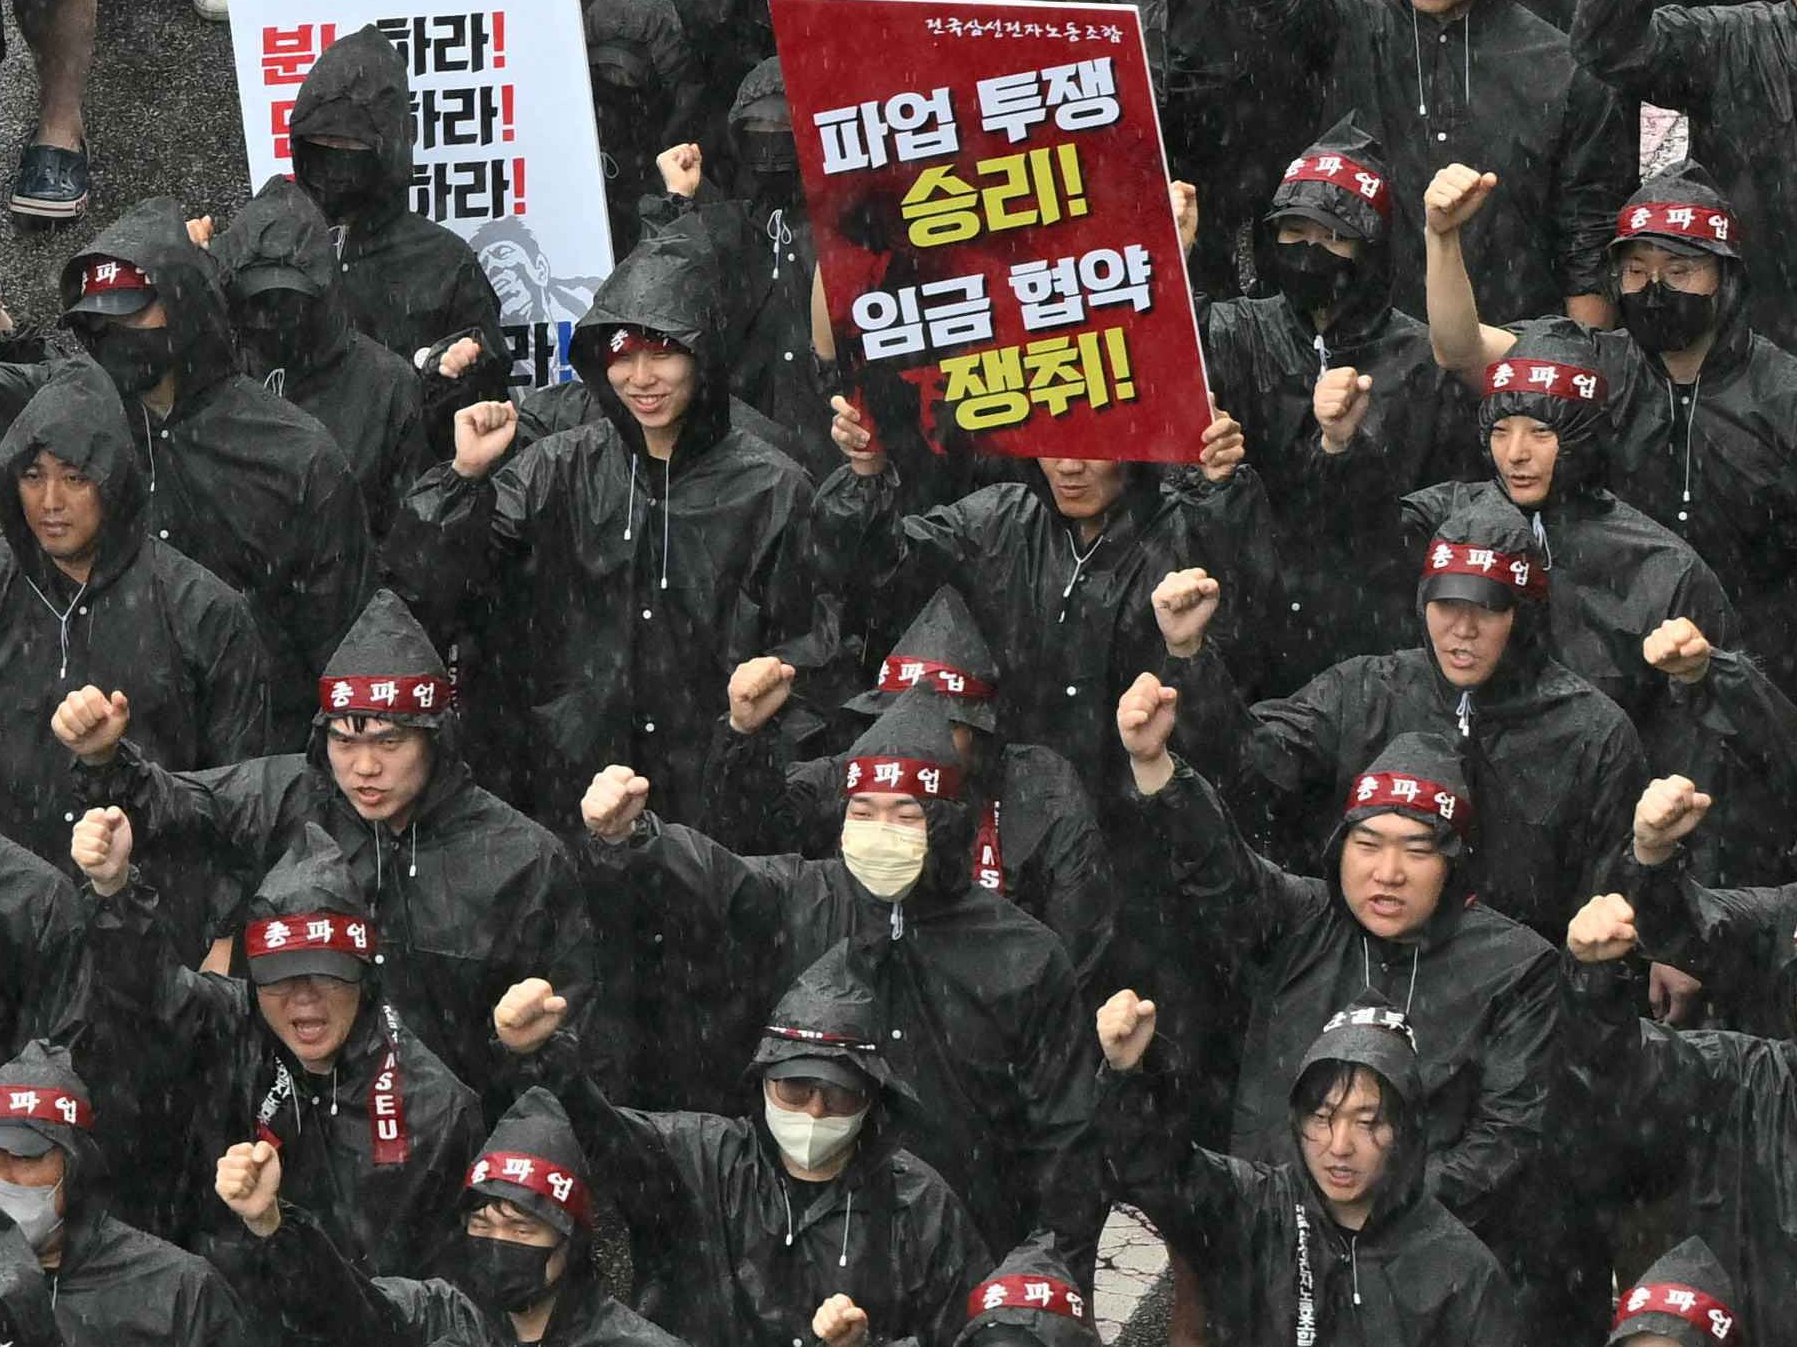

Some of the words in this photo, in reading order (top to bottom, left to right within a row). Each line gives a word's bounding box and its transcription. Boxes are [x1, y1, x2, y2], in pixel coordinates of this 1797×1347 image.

[813, 88, 959, 174] 파업
[977, 57, 1120, 144] 투쟁
[901, 144, 1087, 247] 승리!
[852, 275, 992, 360] 임금
[1008, 244, 1150, 331] 협약
[939, 328, 1135, 431] 쟁취!
